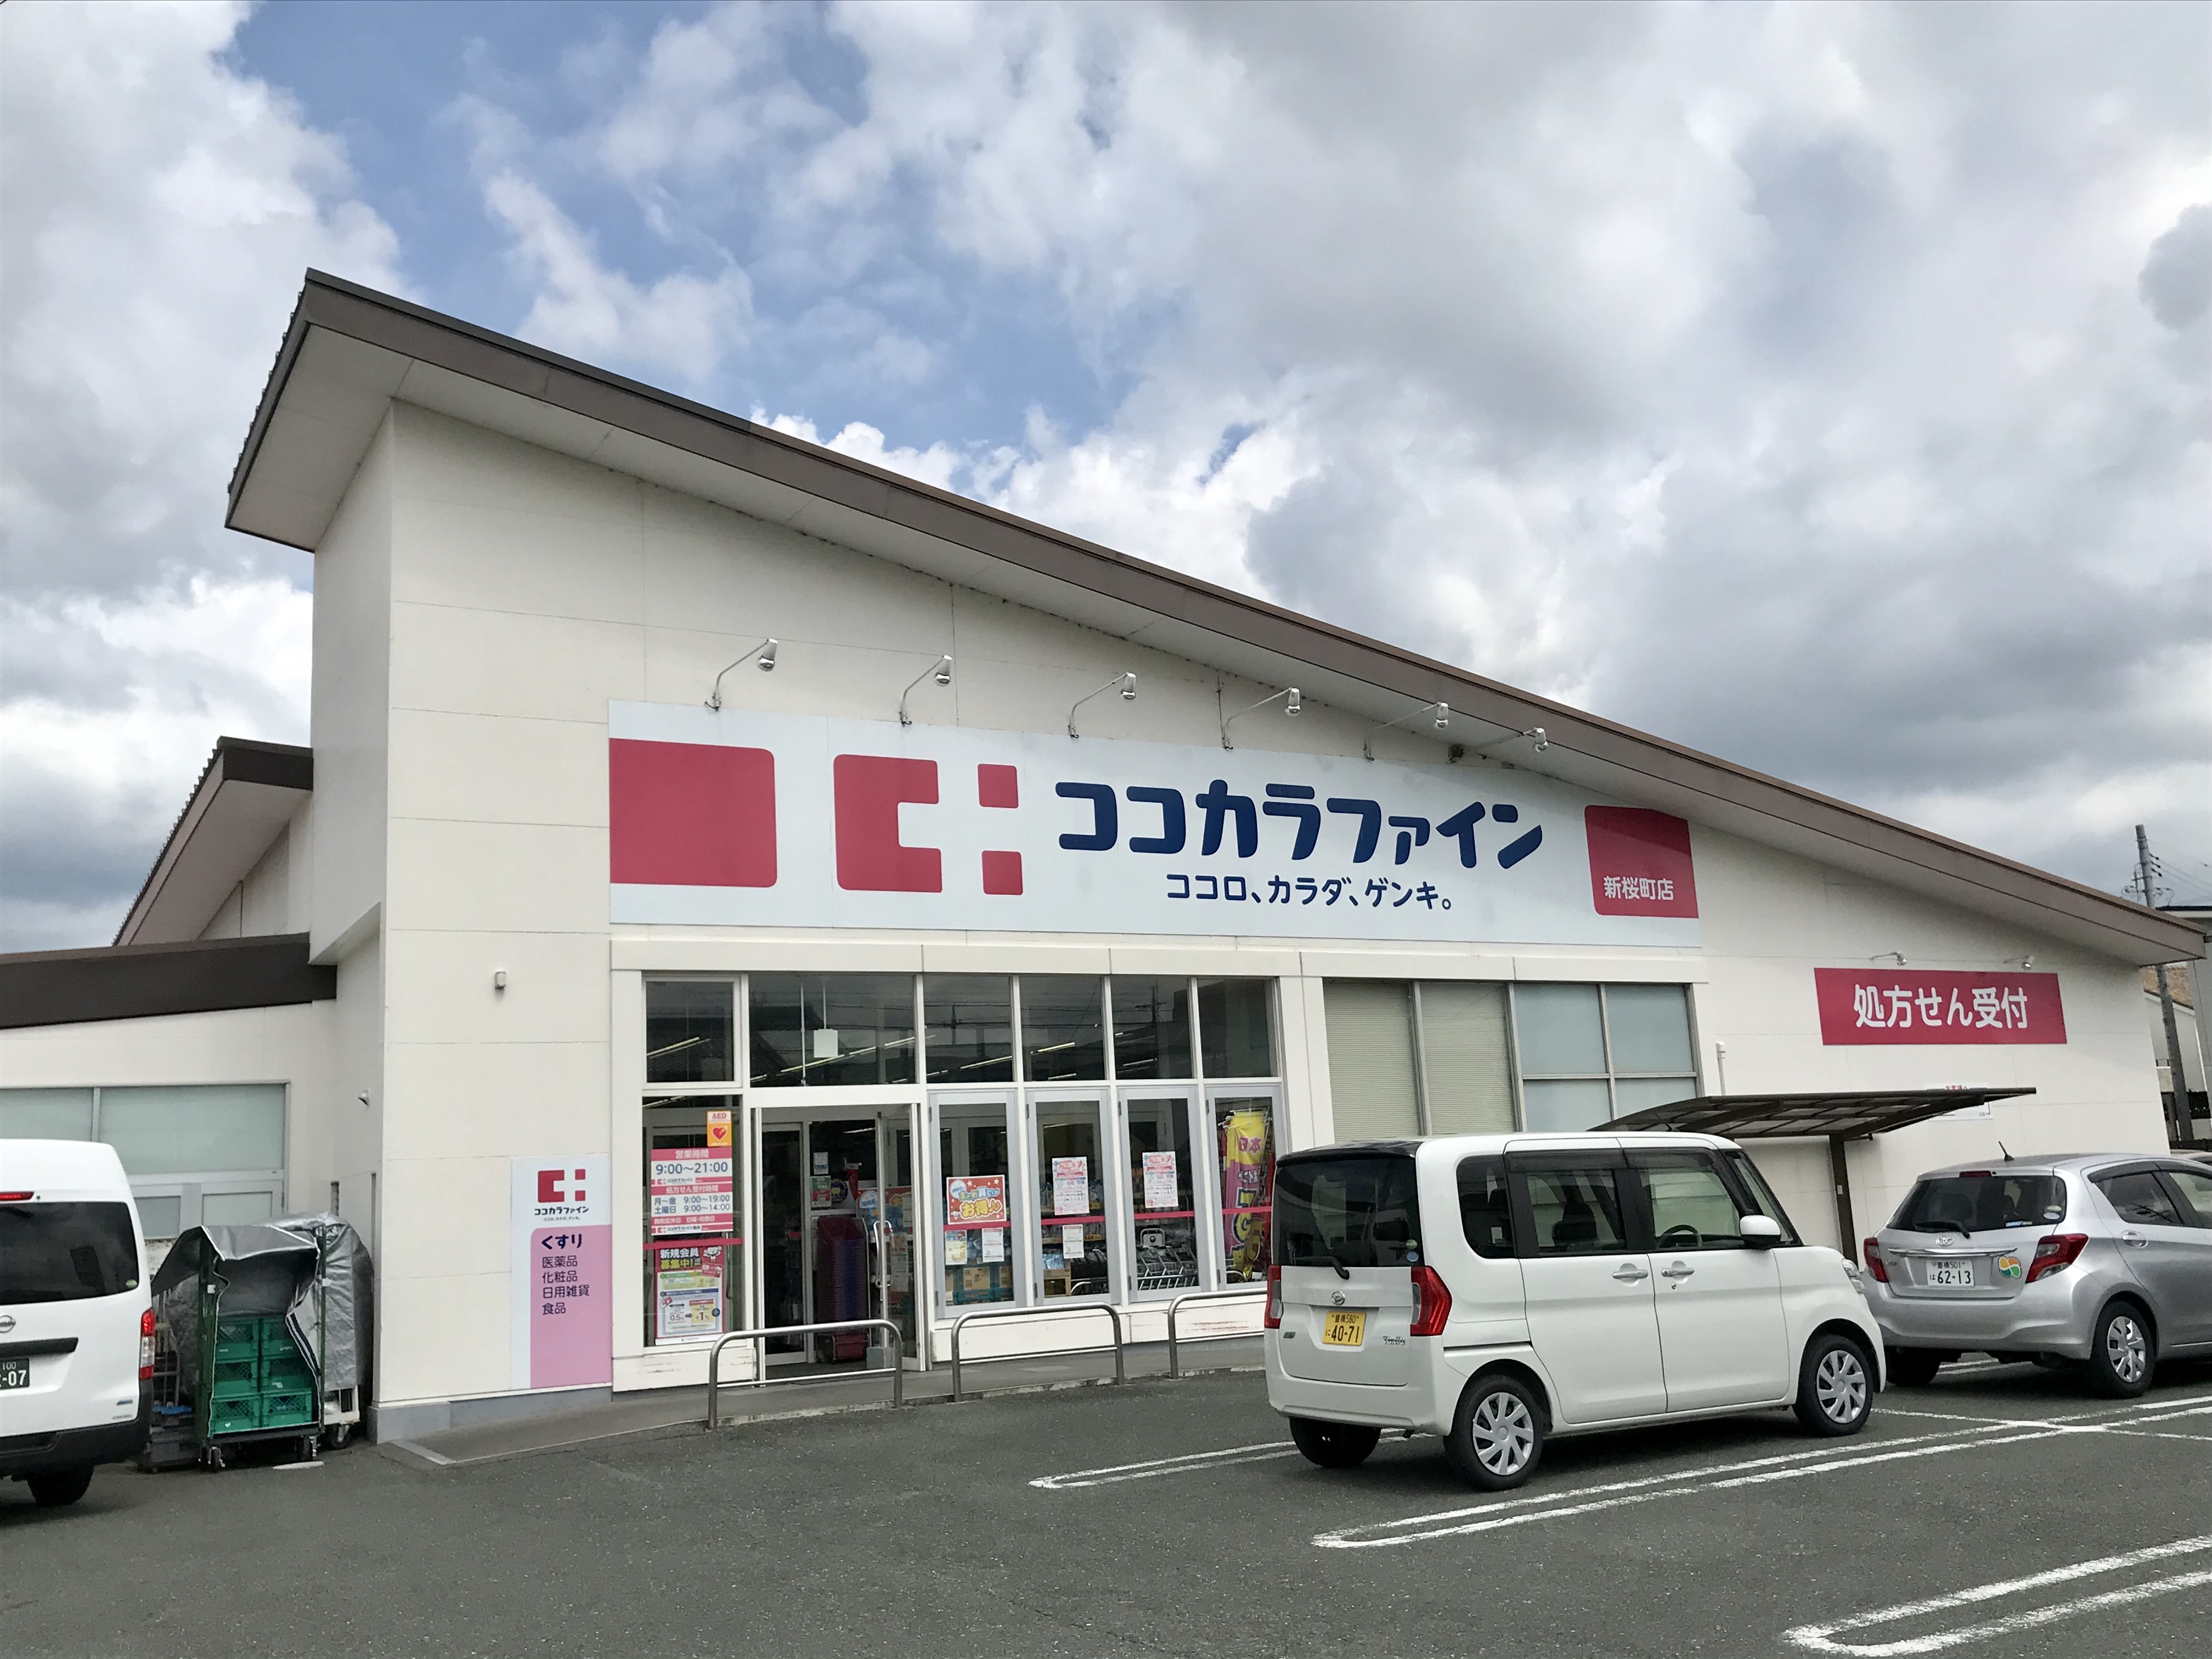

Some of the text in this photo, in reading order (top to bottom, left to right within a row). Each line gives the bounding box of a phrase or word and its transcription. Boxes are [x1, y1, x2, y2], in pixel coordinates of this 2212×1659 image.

[1055, 778, 1542, 869] ココカラファイン
[1604, 876, 1673, 900] 新桜町店
[1854, 984, 2028, 1028] 処方せん受付
[675, 1149, 709, 1159] 営業時間
[534, 1206, 589, 1215] ココカラファイン
[654, 1206, 676, 1214] 土曜日
[541, 1233, 582, 1250] くすり
[660, 1247, 699, 1259] 新規会員
[542, 1255, 578, 1269] 医薬品
[541, 1270, 578, 1284] 化粧品
[1937, 1270, 1971, 1284] 62-13
[543, 1284, 590, 1299] 日用雑貨
[542, 1302, 566, 1315] 食品
[1331, 1324, 1359, 1343] 40-71
[2, 1361, 16, 1370] 100
[0, 1369, 27, 1386] -07
